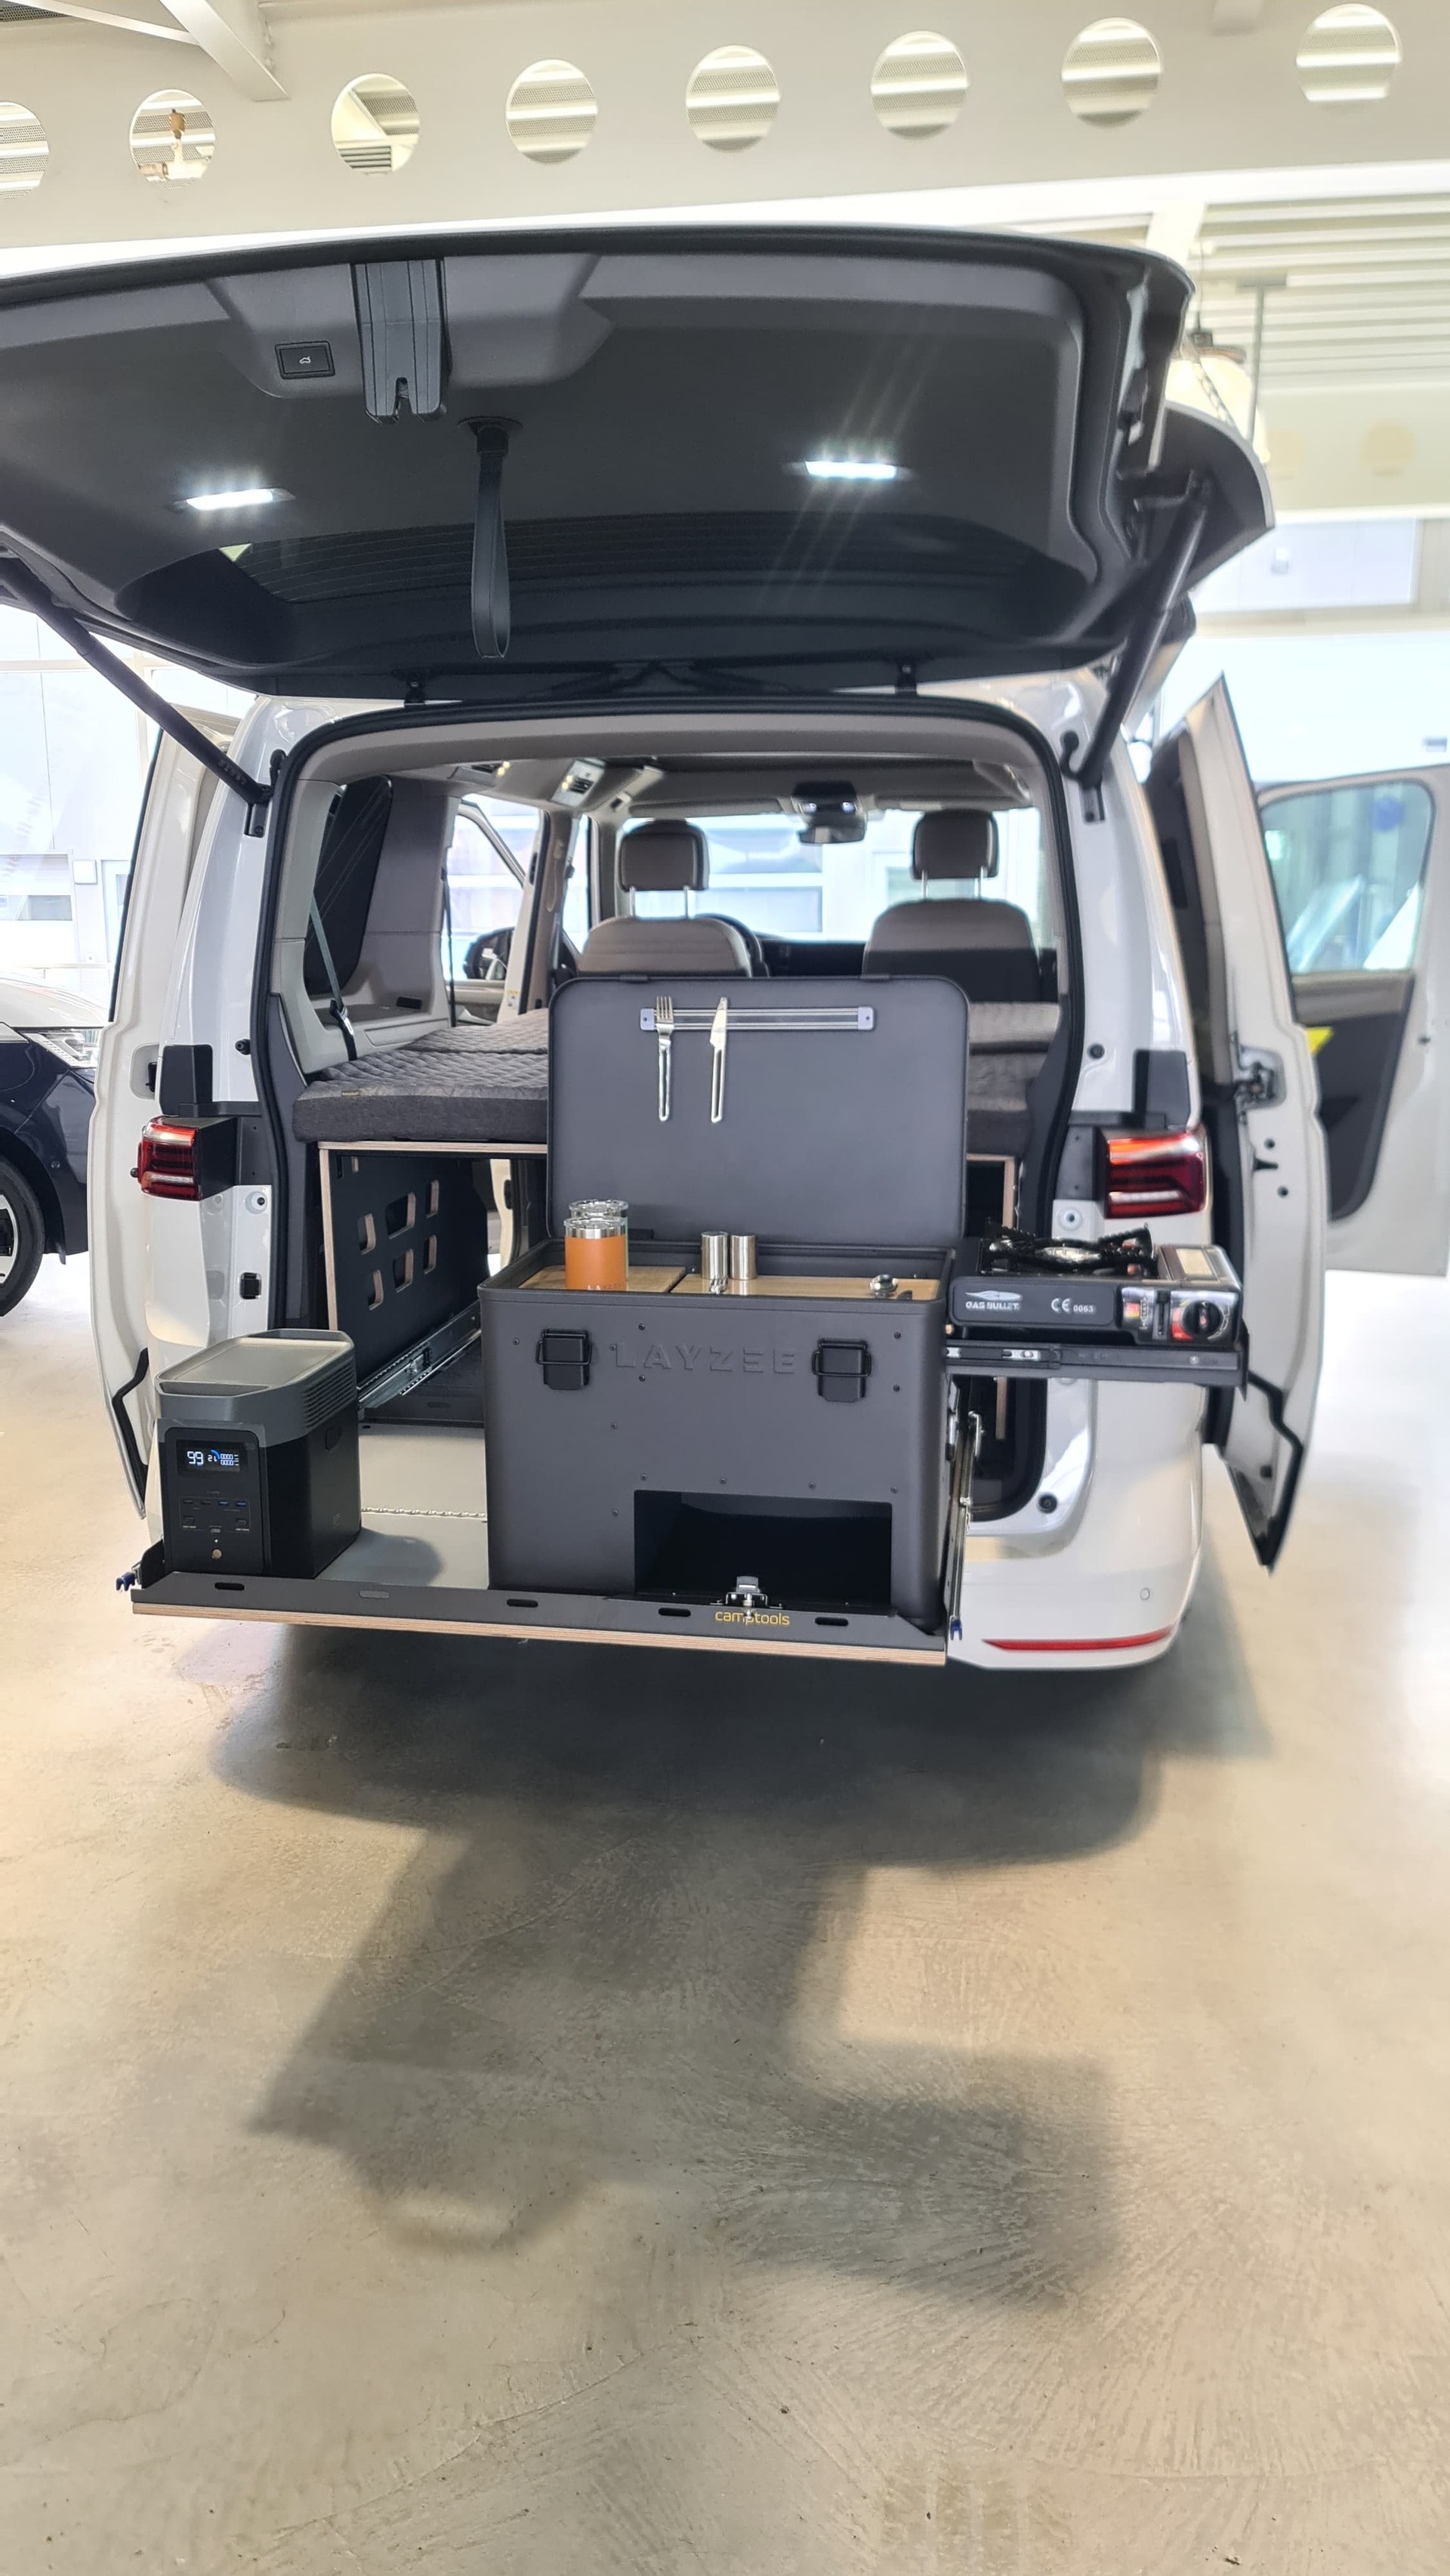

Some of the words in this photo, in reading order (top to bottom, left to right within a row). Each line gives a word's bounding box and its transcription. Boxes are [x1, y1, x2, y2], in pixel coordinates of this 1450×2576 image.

[965, 1301, 985, 1310] GAS
[615, 1341, 795, 1375] LAYZEE
[187, 1450, 204, 1466] 99
[714, 1611, 790, 1626] camptools
